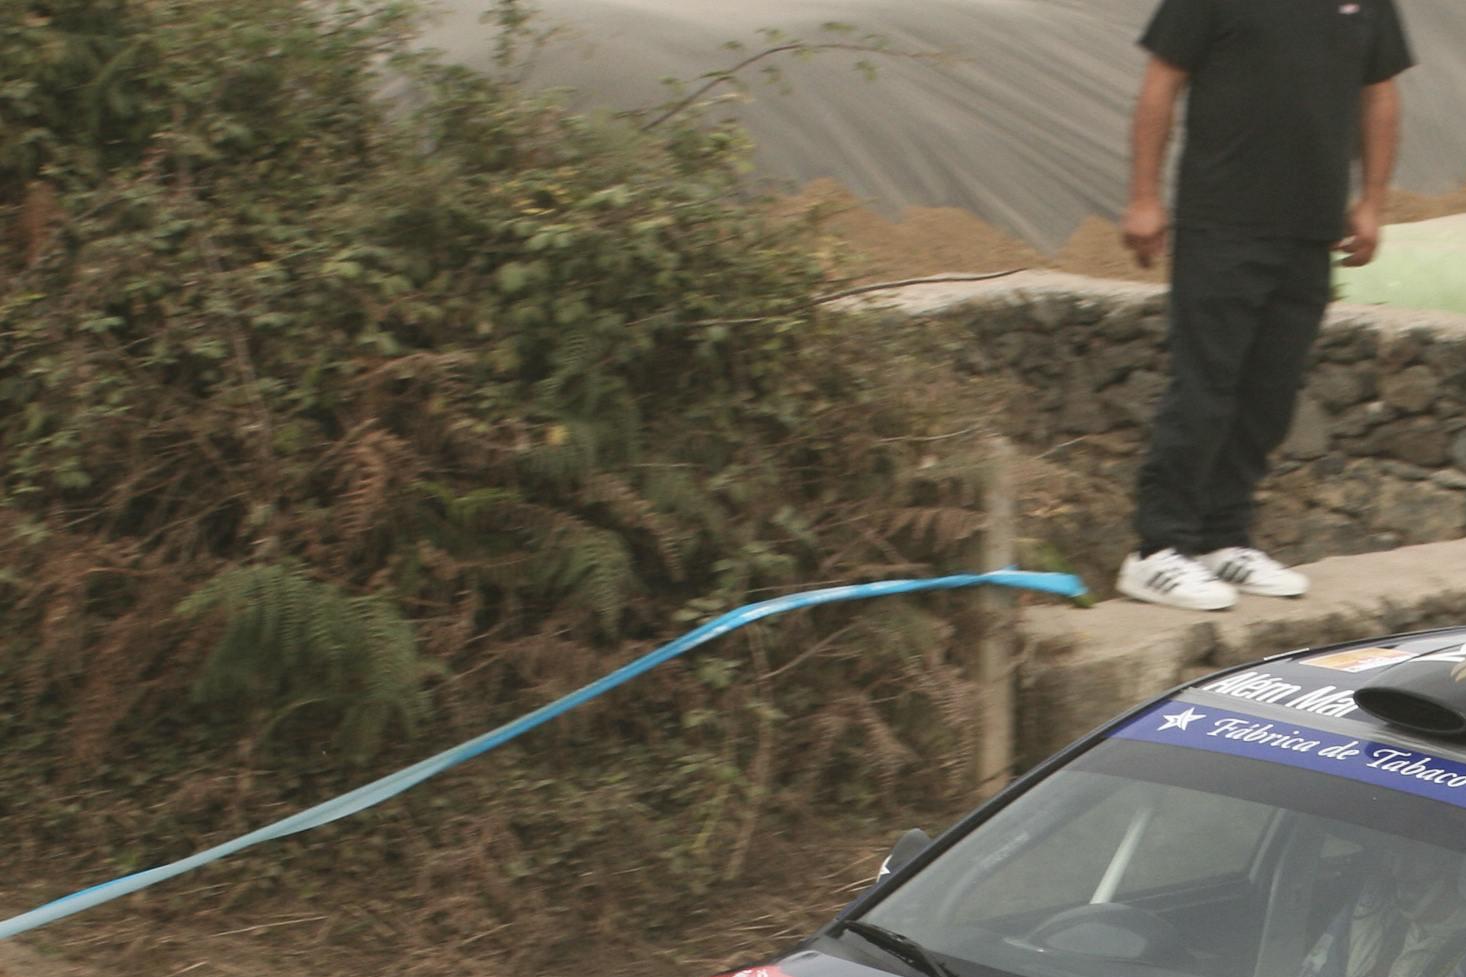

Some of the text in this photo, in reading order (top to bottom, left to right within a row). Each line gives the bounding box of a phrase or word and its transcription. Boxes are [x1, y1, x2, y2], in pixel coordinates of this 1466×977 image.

[1201, 671, 1302, 704] Além
[1207, 717, 1320, 752] Fábrica
[1317, 741, 1360, 761] de
